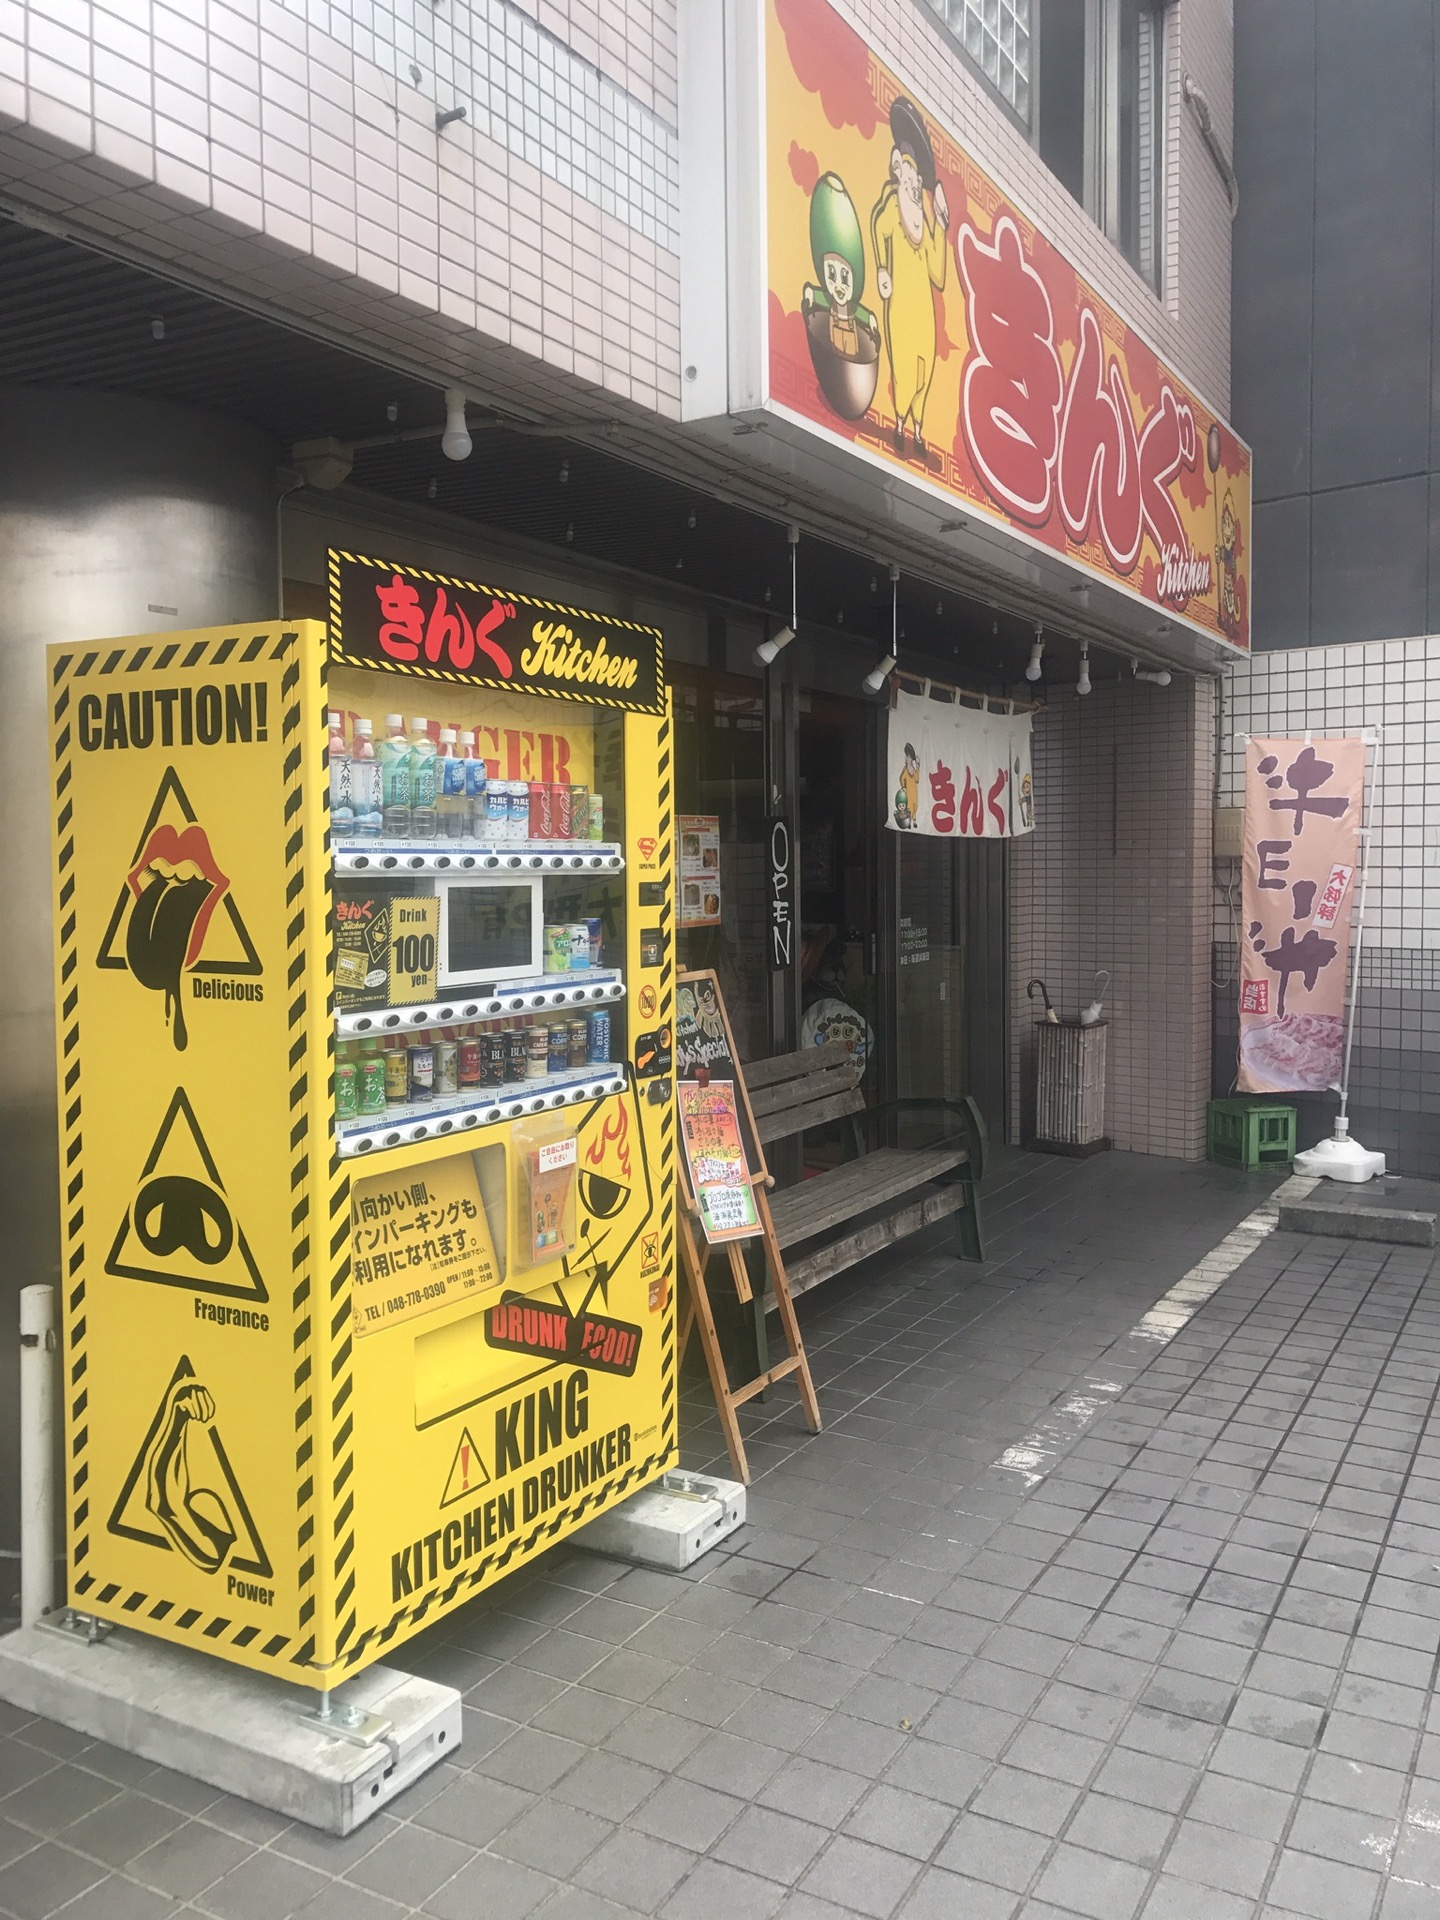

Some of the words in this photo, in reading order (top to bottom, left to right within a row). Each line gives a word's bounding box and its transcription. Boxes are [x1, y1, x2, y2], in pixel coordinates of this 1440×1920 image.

[956, 214, 1196, 608] きんぐ
[1157, 542, 1210, 597] Kitchen
[375, 574, 517, 679] きんぐ
[521, 621, 638, 689] Kitchen
[78, 681, 267, 751] CAUTION!
[340, 758, 352, 805] 天然水
[928, 759, 1009, 836] きんぐ
[336, 900, 375, 921] きんぐ
[771, 821, 791, 965] OPEN
[400, 908, 427, 923] Drink
[392, 933, 435, 974] 100
[193, 977, 264, 1001] Delicious
[676, 1022, 698, 1037] itchen
[541, 1140, 575, 1157] ご自由にお取り
[548, 1153, 568, 1165] ください
[364, 1304, 381, 1321] TEL
[387, 1281, 446, 1313] 048-778-0390
[446, 1275, 458, 1284] OPEN
[194, 1297, 269, 1332] Fragrance
[491, 1304, 568, 1352] DRUNK
[580, 1321, 637, 1367] FOOD!
[495, 1369, 588, 1480] KING
[391, 1487, 515, 1604] KITCHEN
[522, 1423, 631, 1525] DRUNKER
[227, 1574, 275, 1607] Power
